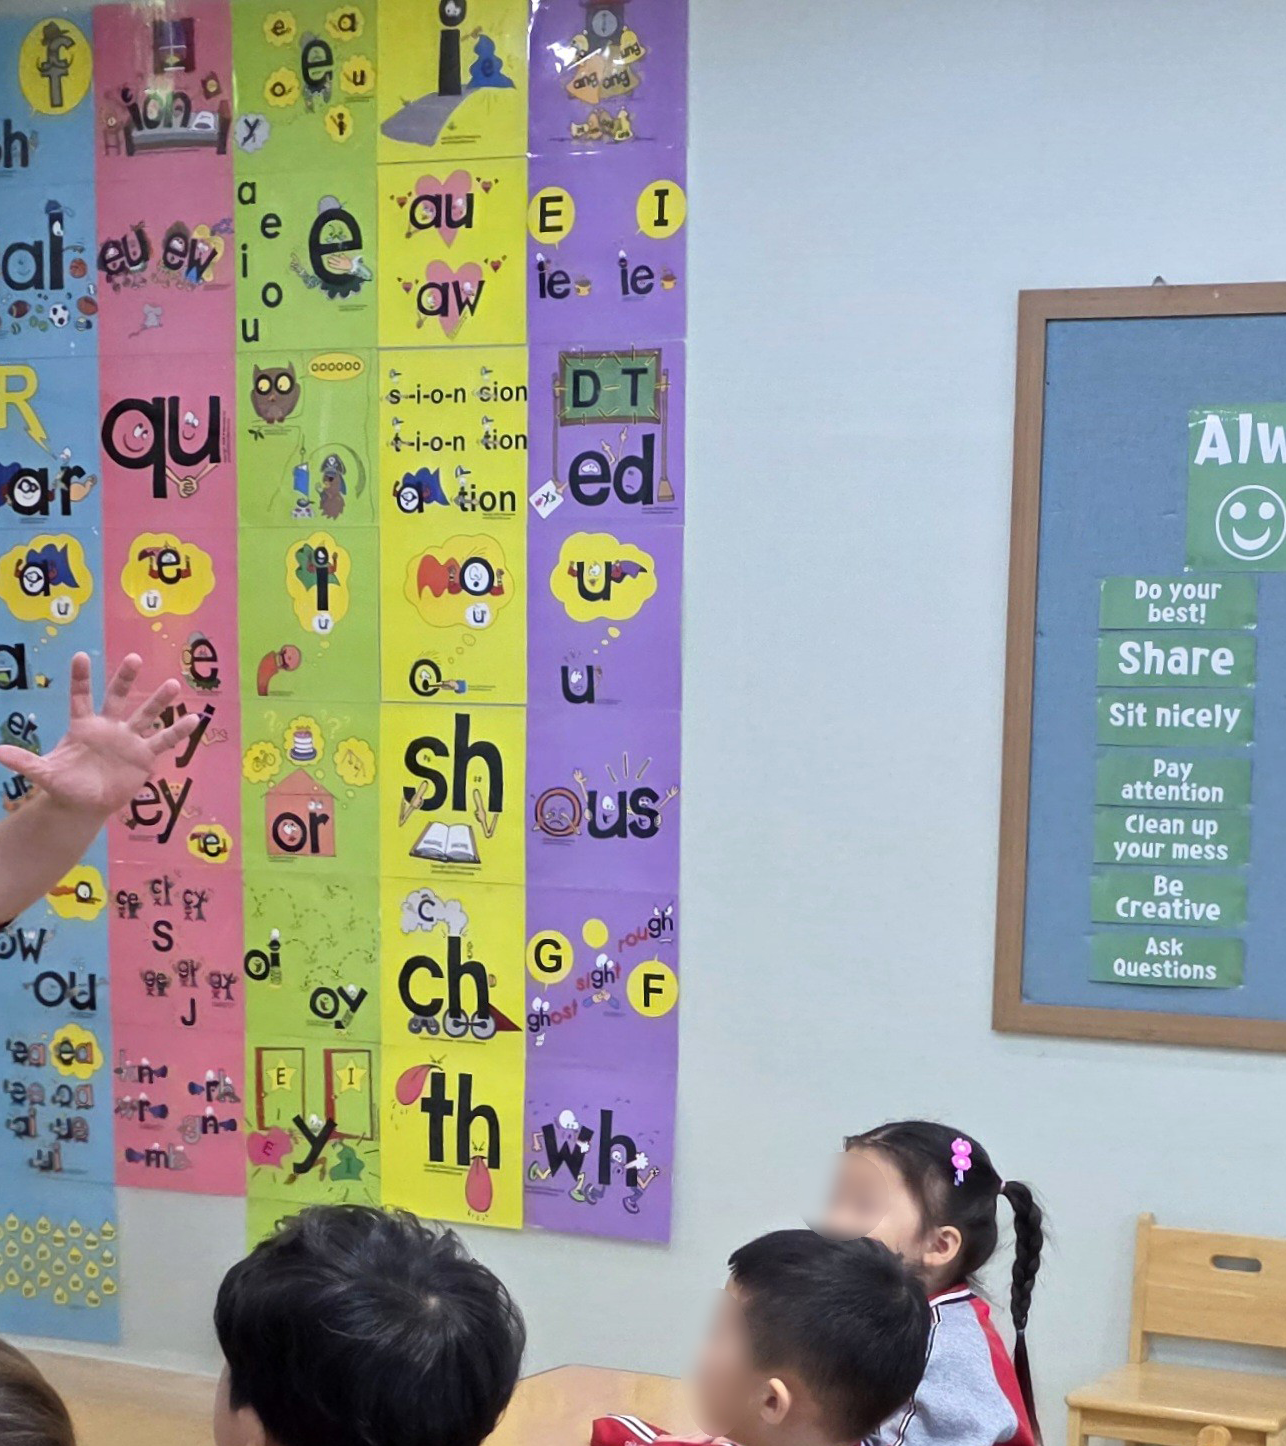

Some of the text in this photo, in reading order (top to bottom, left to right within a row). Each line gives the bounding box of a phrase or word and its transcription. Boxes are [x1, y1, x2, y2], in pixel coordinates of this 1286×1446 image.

[238, 181, 257, 205] a
[653, 189, 669, 226] I
[261, 213, 281, 238] e
[410, 193, 474, 228] au
[539, 196, 563, 232] E
[241, 245, 248, 277] i
[619, 257, 654, 296] ie
[262, 282, 283, 308] o
[537, 260, 571, 299] ie
[417, 280, 485, 317] aw
[242, 318, 259, 342] u
[479, 381, 527, 403] sion
[572, 368, 647, 408] D T
[102, 396, 220, 498] qu
[483, 429, 528, 451] tion
[569, 433, 654, 506] ed
[11, 466, 85, 515] ar
[457, 482, 515, 512] tion
[1135, 580, 1221, 604] Do your
[1148, 604, 1206, 624] best!
[1118, 641, 1234, 675] Share
[1109, 702, 1240, 732] Sit nicely
[404, 713, 503, 812] sh
[1153, 759, 1192, 782] Pay
[1122, 782, 1224, 802] attention
[130, 778, 193, 843] ey
[535, 787, 660, 840] ous
[1125, 815, 1218, 839] Clean up
[273, 810, 329, 853] or
[1114, 841, 1228, 862] your mess
[1153, 875, 1183, 896] Be
[1116, 897, 1221, 920] Creative
[152, 920, 173, 952] S
[619, 912, 673, 952] rough
[1146, 937, 1183, 956] Ask
[244, 939, 281, 981] oi
[535, 939, 562, 973] G
[1114, 958, 1216, 980] Questions
[34, 971, 96, 1011] ou
[397, 936, 490, 1019] ch
[577, 962, 621, 991] sight
[643, 974, 664, 1007] F
[181, 998, 195, 1026] J
[310, 986, 368, 1029] oy
[527, 999, 577, 1032] ghost
[421, 1072, 500, 1169] th
[291, 1113, 337, 1173] y
[542, 1109, 637, 1187] wh
